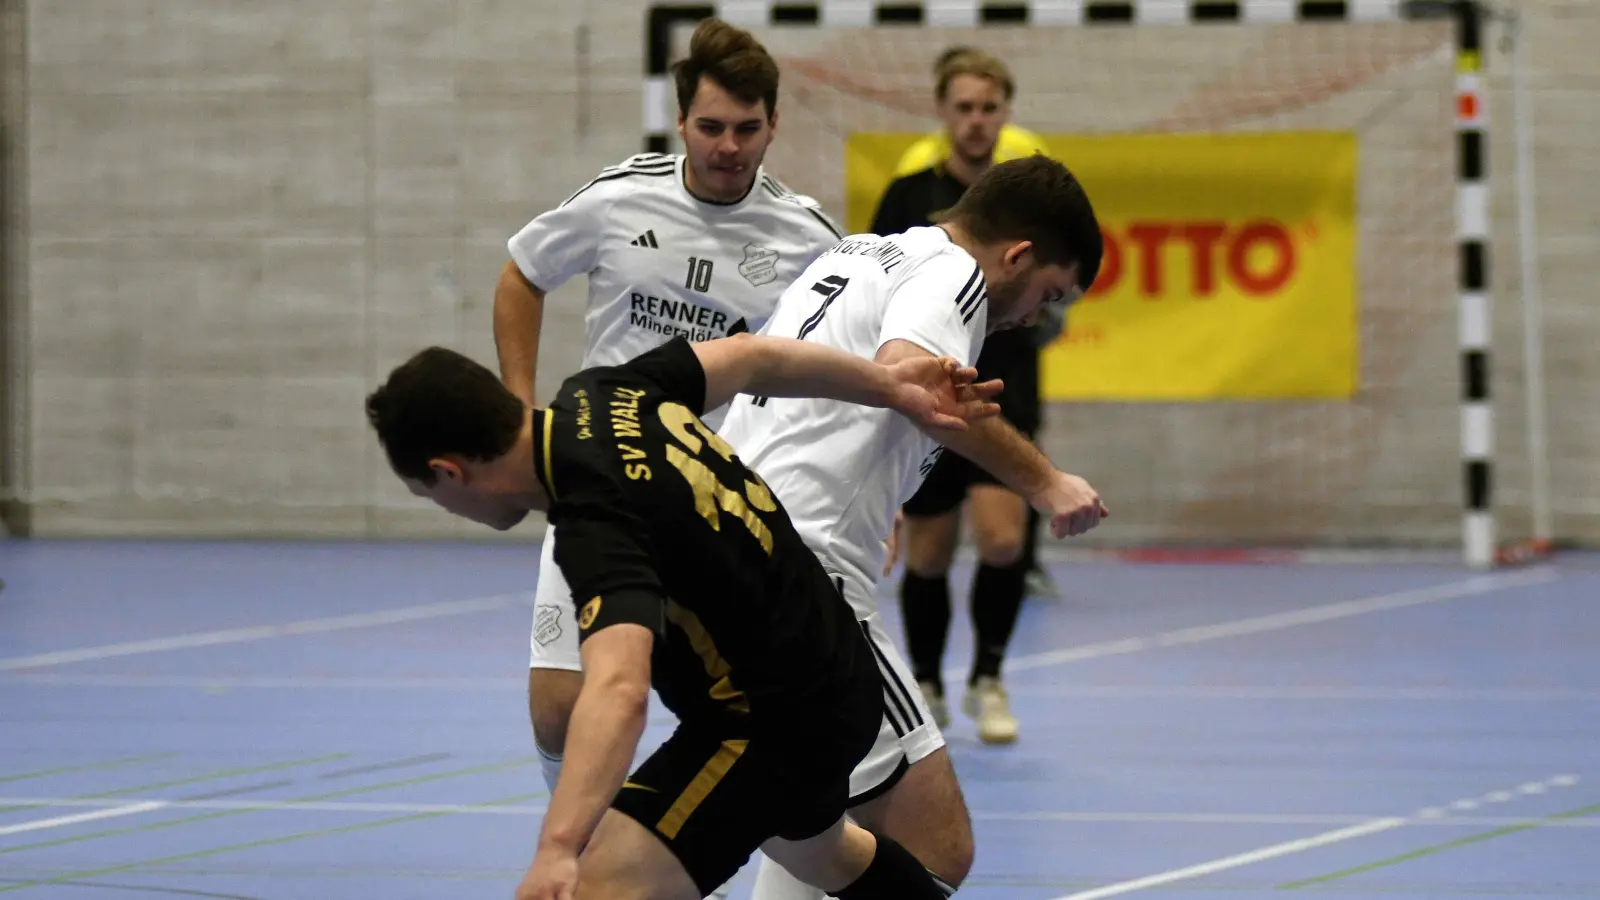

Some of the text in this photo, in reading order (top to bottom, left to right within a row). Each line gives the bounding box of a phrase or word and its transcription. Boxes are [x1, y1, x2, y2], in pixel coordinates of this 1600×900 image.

[684, 256, 714, 293] 10
[630, 292, 728, 332] RENNER
[630, 312, 721, 343] Mineralöl
[616, 443, 653, 481] SV
